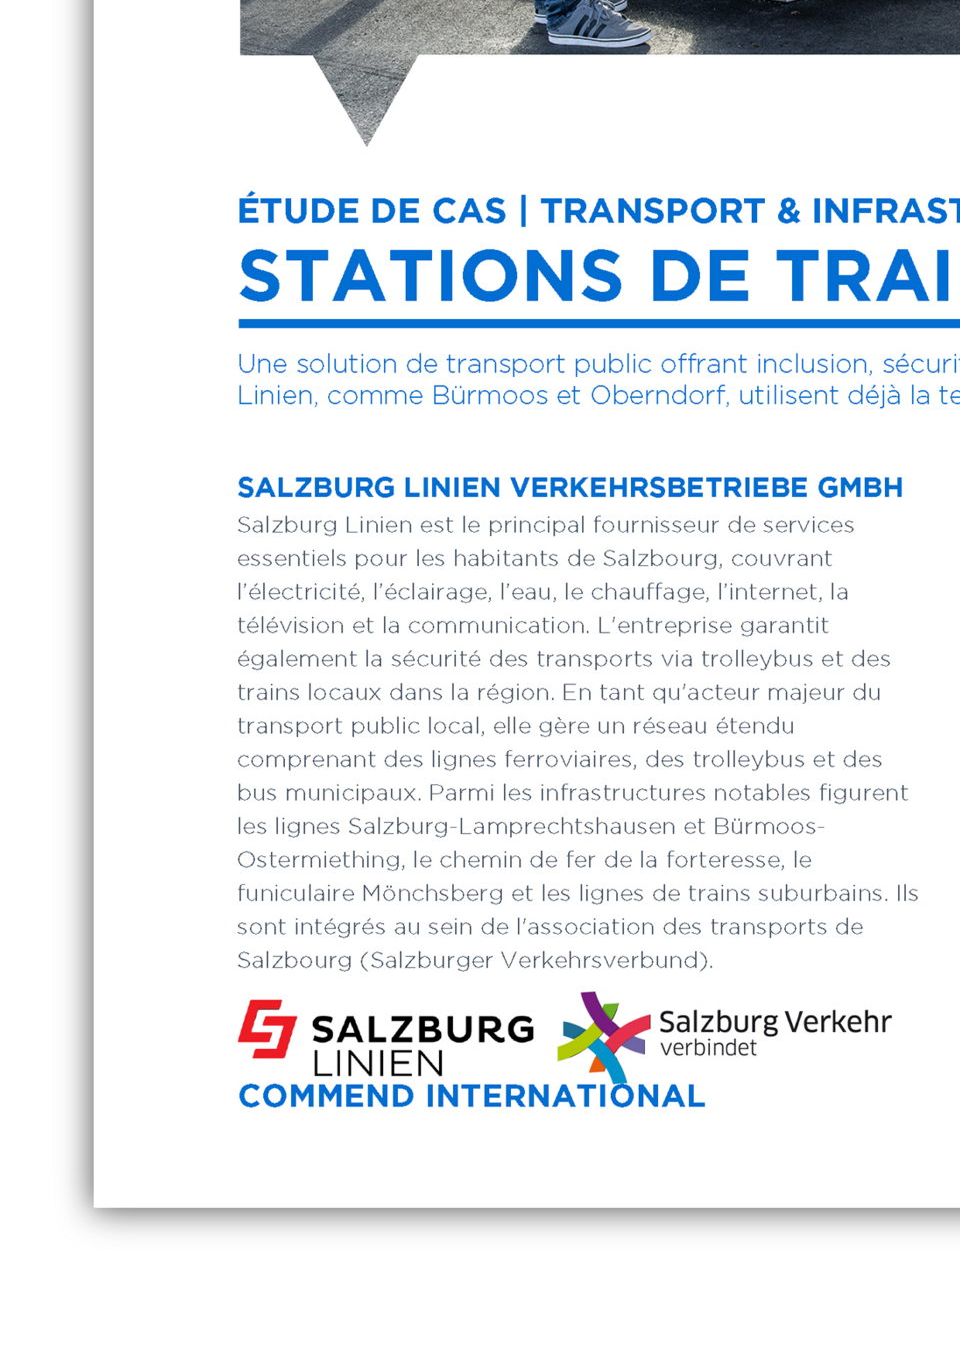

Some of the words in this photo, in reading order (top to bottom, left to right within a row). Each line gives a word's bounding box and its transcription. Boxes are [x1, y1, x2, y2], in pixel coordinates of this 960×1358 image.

[238, 189, 360, 225] ÉTUDE
[371, 197, 420, 224] DE
[432, 196, 507, 225] CAS
[539, 196, 766, 225] TRANSPORT
[777, 196, 802, 225] &
[238, 248, 623, 303] STATIONS
[652, 248, 750, 302] DE
[238, 352, 288, 374] Une
[296, 352, 397, 374] solution
[405, 352, 439, 374] de
[445, 353, 566, 378] transport
[574, 352, 652, 378] public
[660, 352, 748, 374] offrant
[757, 352, 873, 377] inclusion,
[238, 384, 319, 408] Linien,
[327, 389, 424, 406] comme
[433, 384, 549, 406] Bürmoos
[556, 384, 581, 406] et
[590, 383, 730, 408] Oberndorf,
[739, 383, 840, 406] utilisent
[847, 383, 901, 410] déjà
[911, 383, 930, 406] la
[237, 475, 395, 499] SALZBURG
[404, 476, 501, 498] LINIEN
[509, 475, 808, 499] VERKEHRSBETRIEBE
[817, 475, 903, 499] GMBH
[237, 514, 337, 538] Salzburg
[346, 515, 412, 534] Linien
[420, 516, 454, 534] est
[462, 514, 481, 534] le
[489, 514, 585, 537] principal
[593, 514, 720, 534] fournisseur
[727, 514, 757, 534] de
[762, 515, 855, 534] services
[237, 548, 347, 567] essentiels
[355, 553, 408, 571] pour
[416, 548, 445, 567] les
[454, 548, 559, 567] habitants
[567, 548, 596, 567] de
[603, 548, 723, 571] Salzbourg,
[731, 549, 833, 567] couvrant
[237, 648, 358, 672] également
[365, 648, 383, 668] la
[391, 649, 482, 668] sécurité
[489, 648, 528, 668] des
[536, 650, 653, 671] transports
[661, 649, 693, 668] via
[701, 648, 814, 672] trolleybus
[821, 650, 844, 668] et
[851, 648, 891, 668] des
[237, 750, 377, 772] comprenant
[383, 749, 424, 768] des
[431, 749, 497, 772] lignes
[504, 749, 637, 771] ferroviaires,
[645, 749, 685, 769] des
[693, 749, 805, 772] trolleybus
[812, 750, 836, 769] et
[842, 749, 883, 768] des
[237, 782, 277, 802] bus
[286, 783, 422, 805] municipaux.
[429, 783, 494, 802] Parmi
[503, 782, 532, 802] les
[540, 782, 706, 802] infrastructures
[714, 782, 811, 802] notables
[819, 782, 909, 805] figurent
[237, 816, 268, 835] les
[275, 816, 341, 839] lignes
[348, 816, 676, 839] Salzburg-Lamprechtshausen
[683, 817, 706, 835] et
[714, 816, 825, 835] Bürmoos-
[237, 849, 405, 872] Ostermiething,
[413, 849, 433, 869] le
[439, 849, 522, 869] chemin
[529, 849, 558, 869] de
[566, 849, 596, 869] fer
[604, 849, 633, 869] de
[640, 849, 657, 869] la
[666, 849, 785, 871] forteresse,
[794, 849, 812, 869] le
[237, 950, 352, 973] Salzbourg
[359, 950, 494, 973] (Salzburger
[500, 950, 713, 973] Verkehrsverbund).
[311, 1014, 535, 1044] SALZBURG
[659, 1008, 779, 1038] Salzburg
[783, 1008, 893, 1034] Verkehr
[659, 1037, 758, 1057] verbindet
[313, 1049, 443, 1077] LINIEN
[238, 1082, 415, 1109] COMMEND
[426, 1081, 706, 1109] INTERNATIONAL
